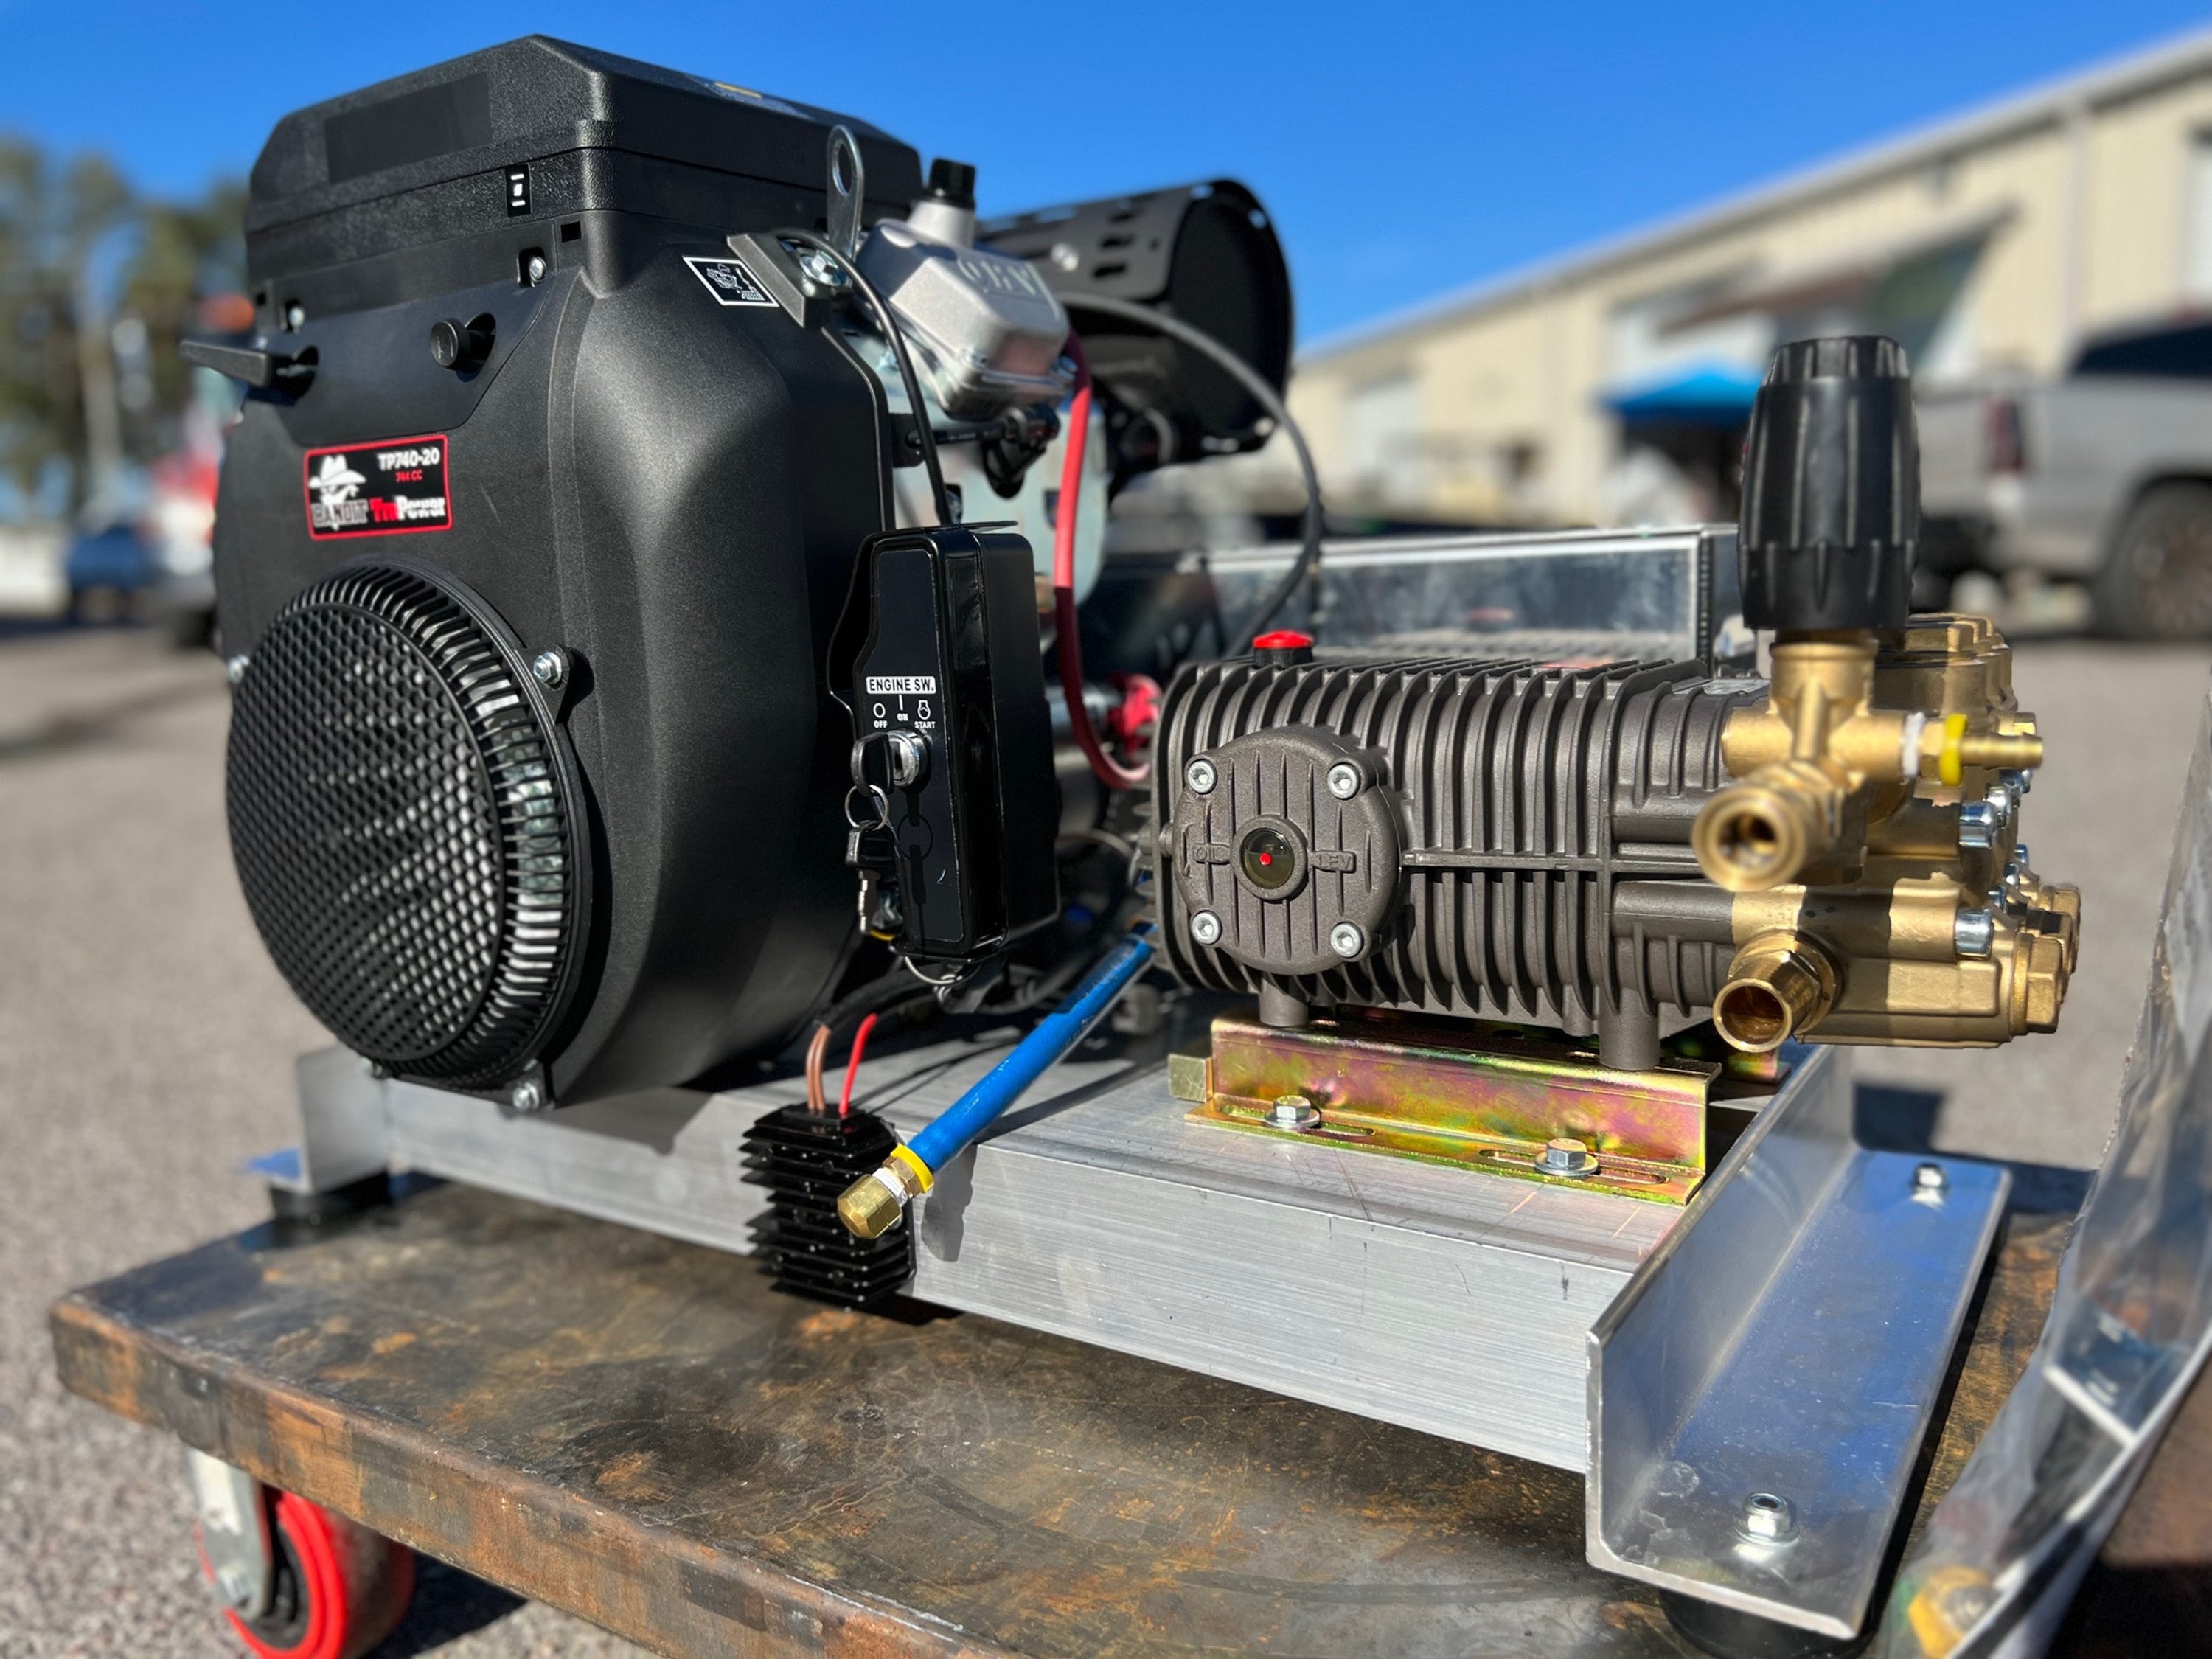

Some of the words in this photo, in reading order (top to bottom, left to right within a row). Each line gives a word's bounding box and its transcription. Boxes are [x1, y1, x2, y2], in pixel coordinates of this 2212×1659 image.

[377, 447, 440, 470] TP740-20
[411, 469, 423, 481] CC
[869, 678, 911, 691] ENGINE
[914, 678, 934, 691] SW.
[897, 713, 908, 721] ON
[873, 720, 888, 728] OFF
[914, 721, 936, 729] START
